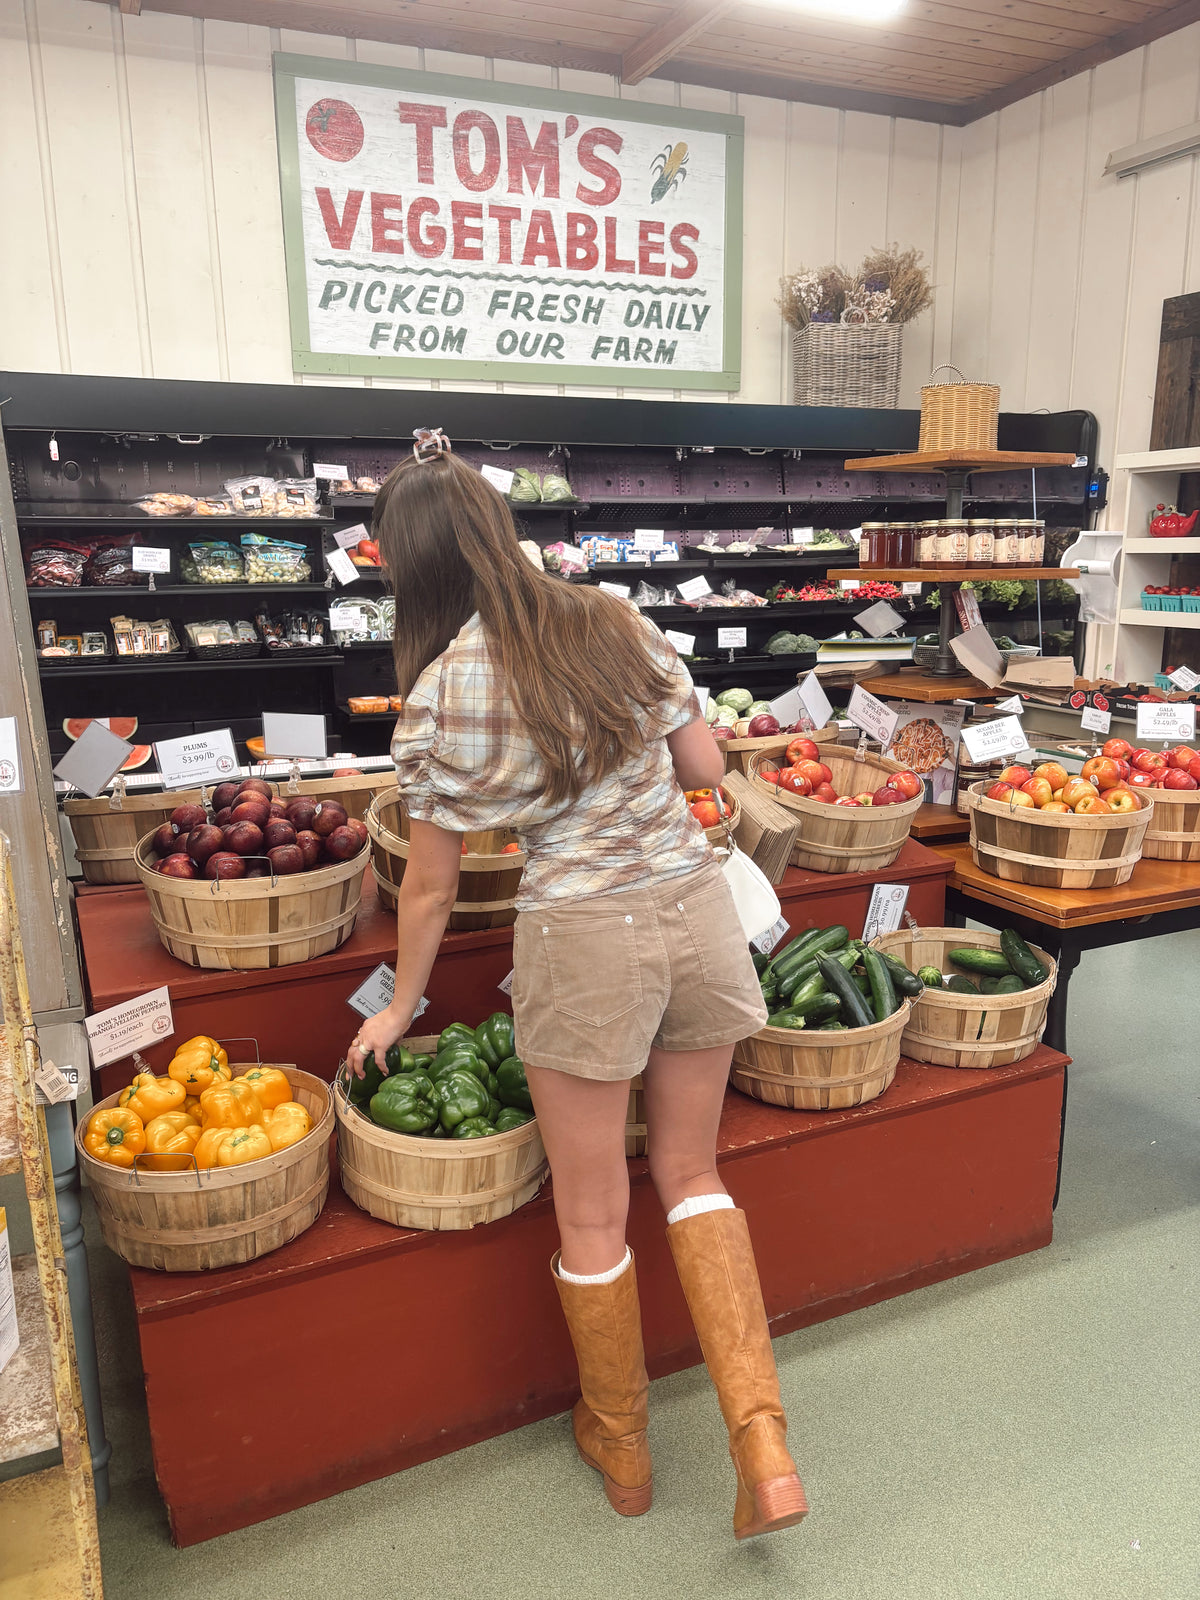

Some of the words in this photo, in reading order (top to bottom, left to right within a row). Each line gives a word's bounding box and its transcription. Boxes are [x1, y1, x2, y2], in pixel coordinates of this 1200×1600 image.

[398, 100, 624, 206] TOM'S
[314, 187, 701, 280] VEGETABLES
[318, 279, 465, 318] PICKED
[487, 290, 605, 326] FRESH
[623, 299, 712, 332] DAILY
[368, 322, 468, 355] FROM
[495, 330, 565, 360] OUR
[591, 335, 678, 365] FARM
[976, 724, 994, 734] SUGAR
[982, 728, 1003, 737] APPLES
[182, 752, 215, 764] $3.99/lb
[183, 742, 208, 752] PLUMS
[380, 970, 395, 984] TOM'S
[88, 1013, 142, 1039] ORANGE/YELLOW
[141, 1001, 167, 1016] PEPPERS
[97, 1016, 117, 1029] TOM'S
[117, 1000, 158, 1020] HOMEGROWN
[110, 1021, 144, 1041] $1.19/each
